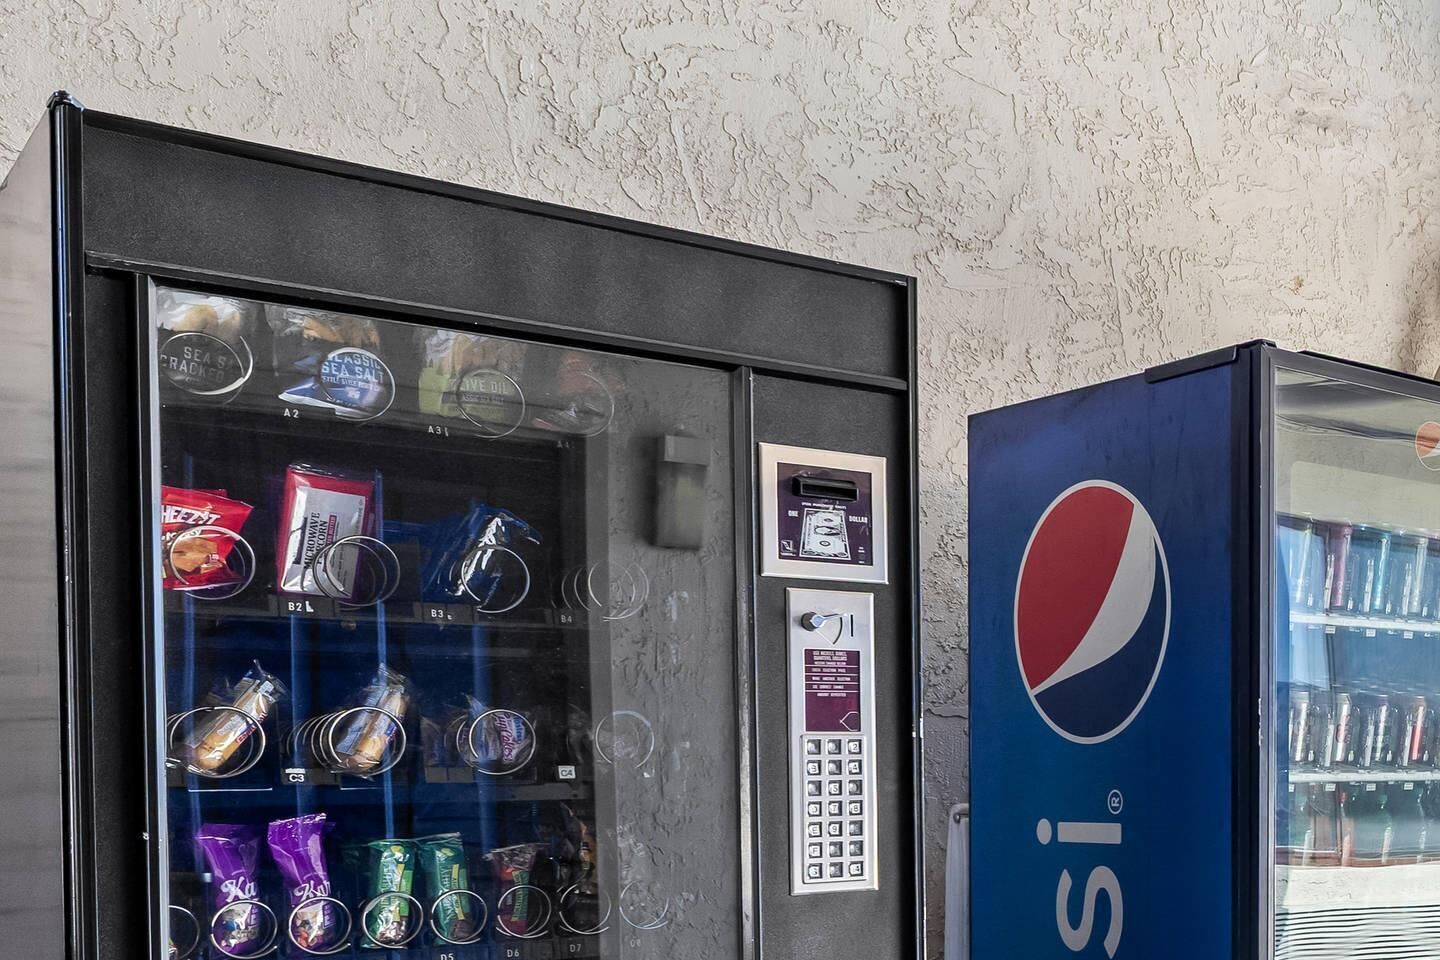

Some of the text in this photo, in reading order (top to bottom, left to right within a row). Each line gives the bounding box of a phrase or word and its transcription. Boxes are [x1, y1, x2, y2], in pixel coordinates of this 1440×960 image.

[183, 346, 210, 365] SEA
[321, 362, 385, 383] SEA SALT
[283, 408, 299, 419] A2
[303, 512, 320, 570] MICROWAVE
[288, 602, 303, 612] B2
[431, 609, 443, 618] B3
[560, 769, 573, 777] C4
[289, 774, 305, 783] C3
[569, 943, 582, 953] D7
[507, 949, 520, 958] D6
